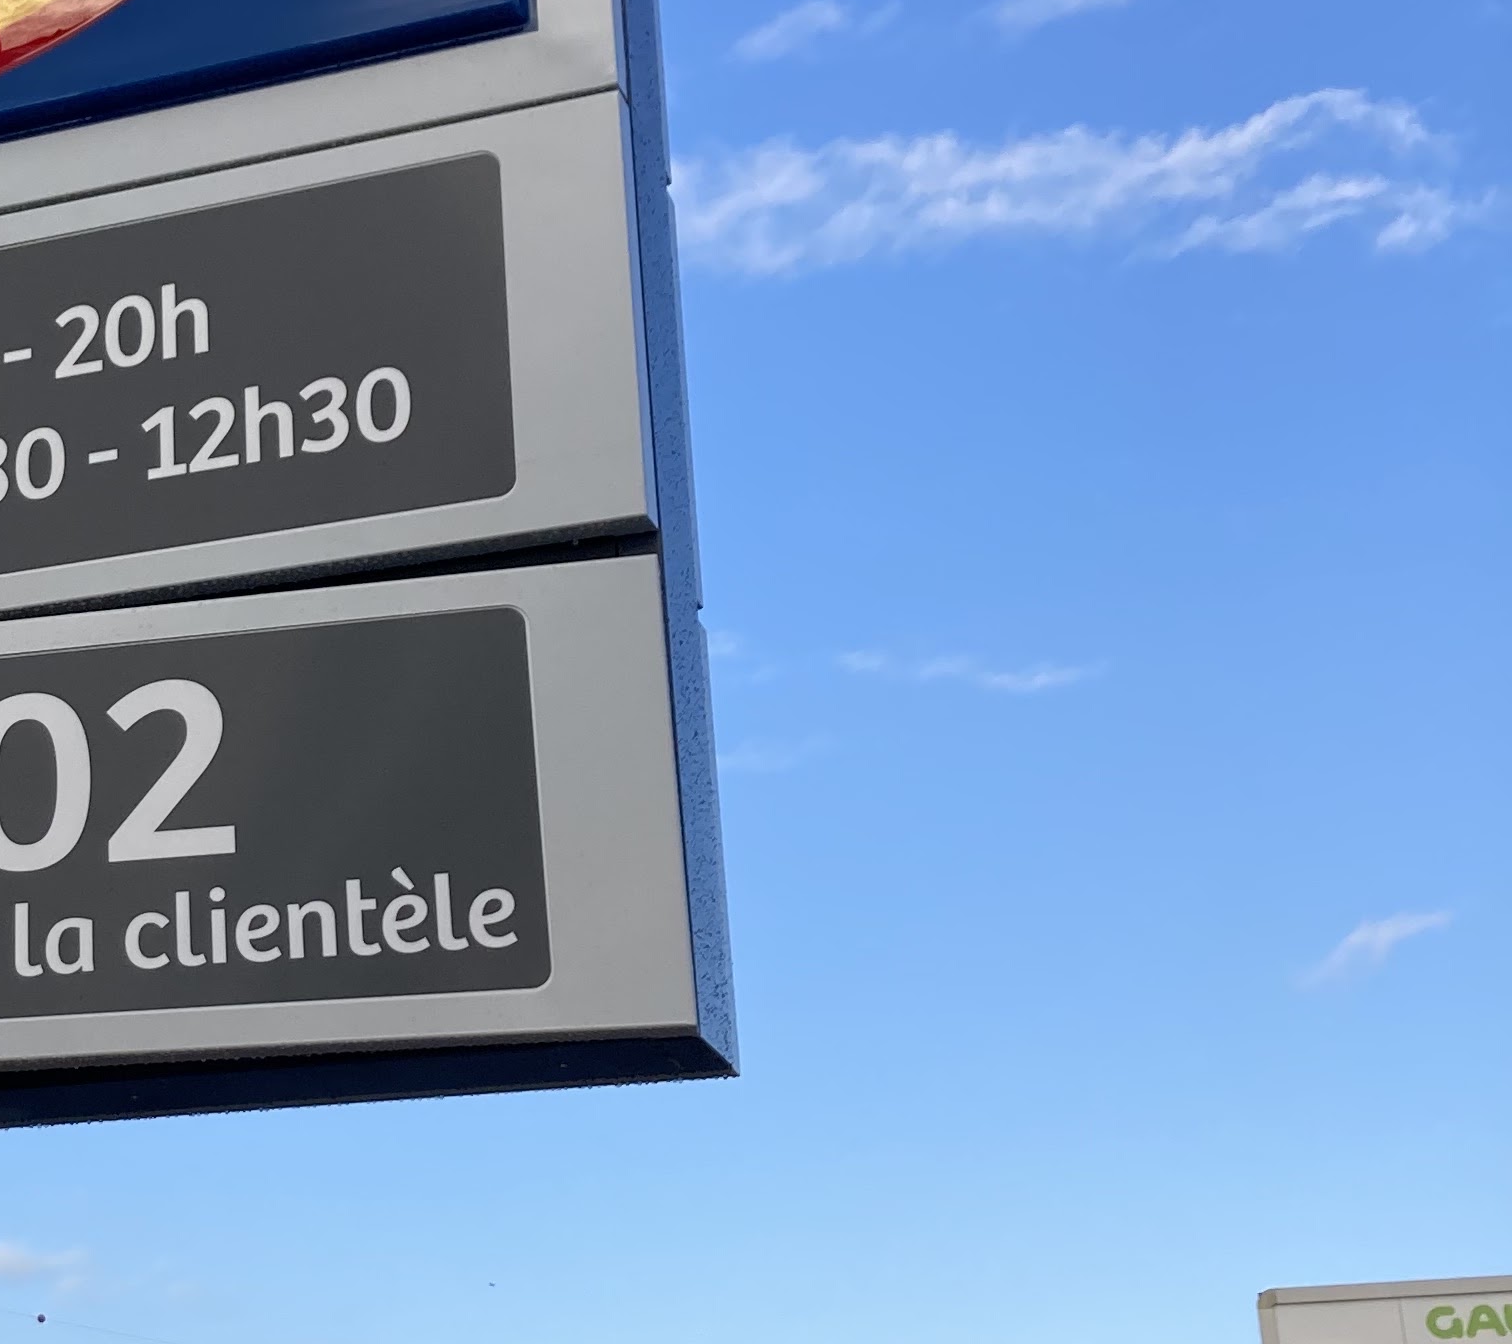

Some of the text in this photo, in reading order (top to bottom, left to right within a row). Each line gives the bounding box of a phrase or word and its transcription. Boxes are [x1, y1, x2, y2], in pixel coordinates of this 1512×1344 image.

[55, 283, 209, 380] 20h
[141, 367, 411, 481] 12h30
[14, 902, 94, 977] la
[124, 866, 518, 970] clientèle
[1426, 1304, 1512, 1340] GA
